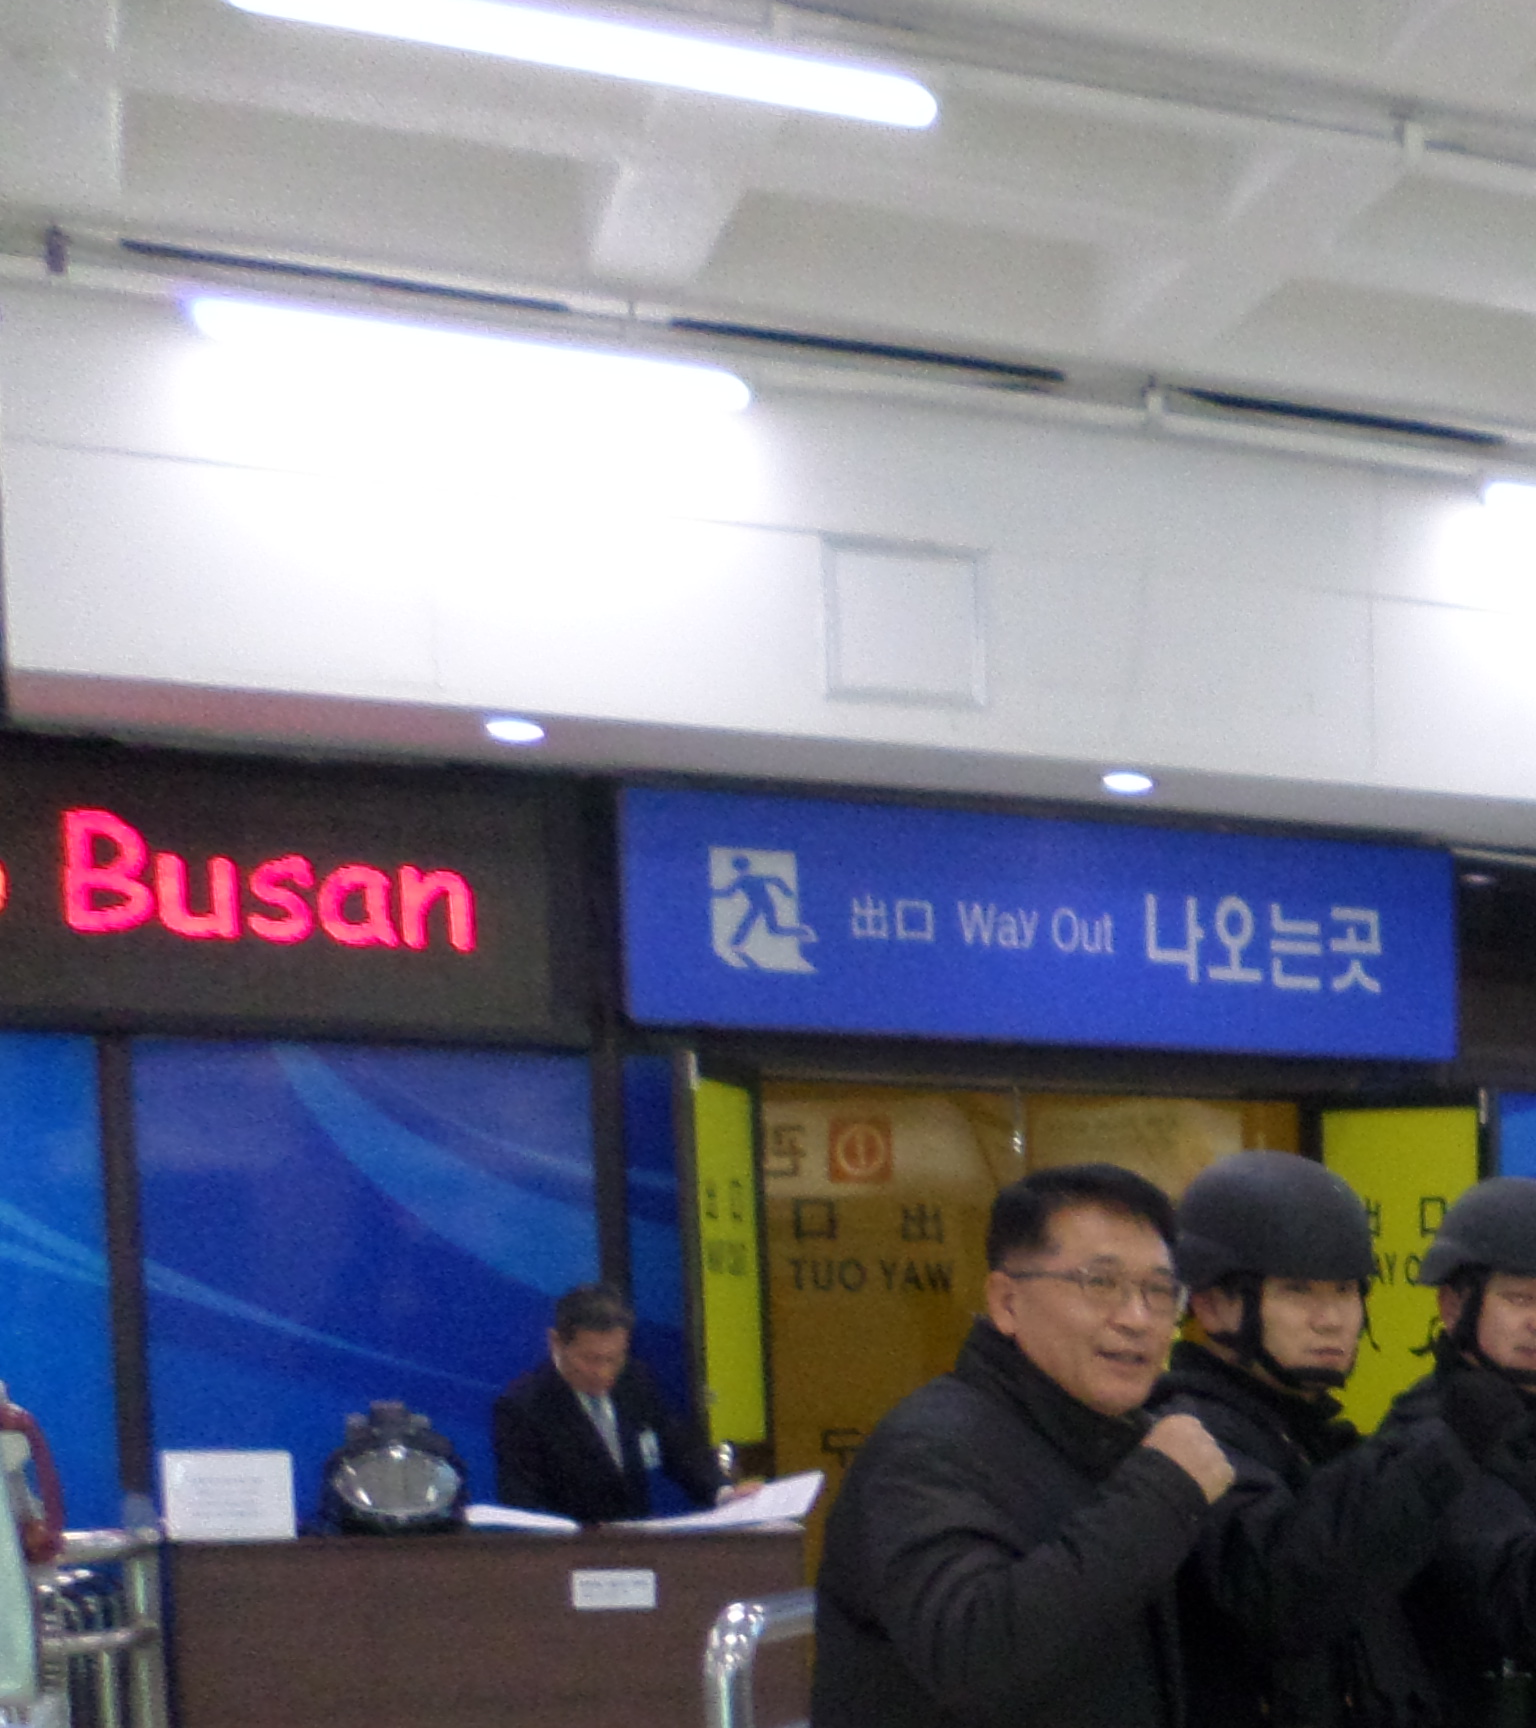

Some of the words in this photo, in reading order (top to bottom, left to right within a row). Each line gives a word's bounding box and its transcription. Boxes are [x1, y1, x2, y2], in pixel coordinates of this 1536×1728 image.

[61, 806, 477, 953] Busan
[850, 894, 934, 943] 出口
[958, 900, 1039, 951] Way
[1051, 907, 1115, 956] Out
[1144, 892, 1383, 995] 나오는곳
